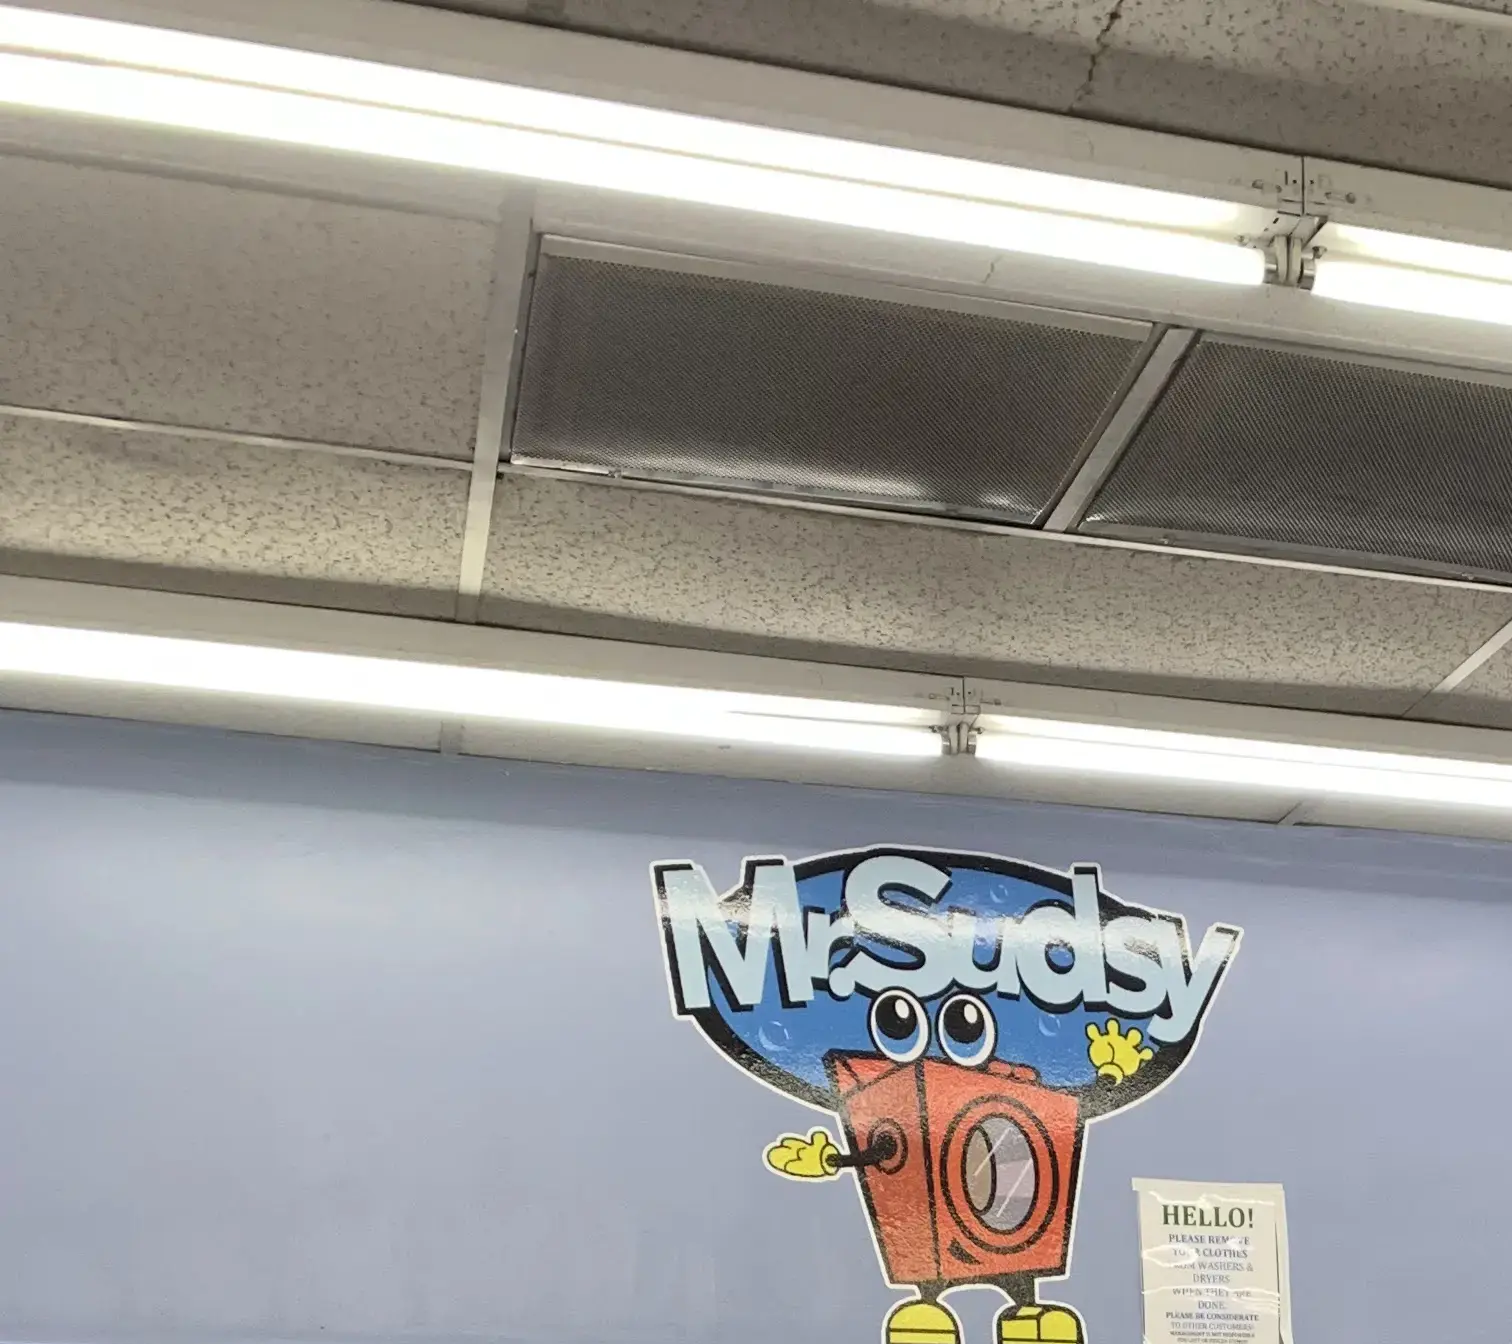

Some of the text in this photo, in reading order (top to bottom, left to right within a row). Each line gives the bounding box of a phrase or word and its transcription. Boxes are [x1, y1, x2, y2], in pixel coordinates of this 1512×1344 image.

[1162, 1204, 1254, 1229] HELLO!
[1168, 1233, 1205, 1244] PLEASE
[1203, 1248, 1248, 1259] CLOTHES
[1197, 1262, 1244, 1271] WASHERS
[1193, 1274, 1230, 1284] DRYERS
